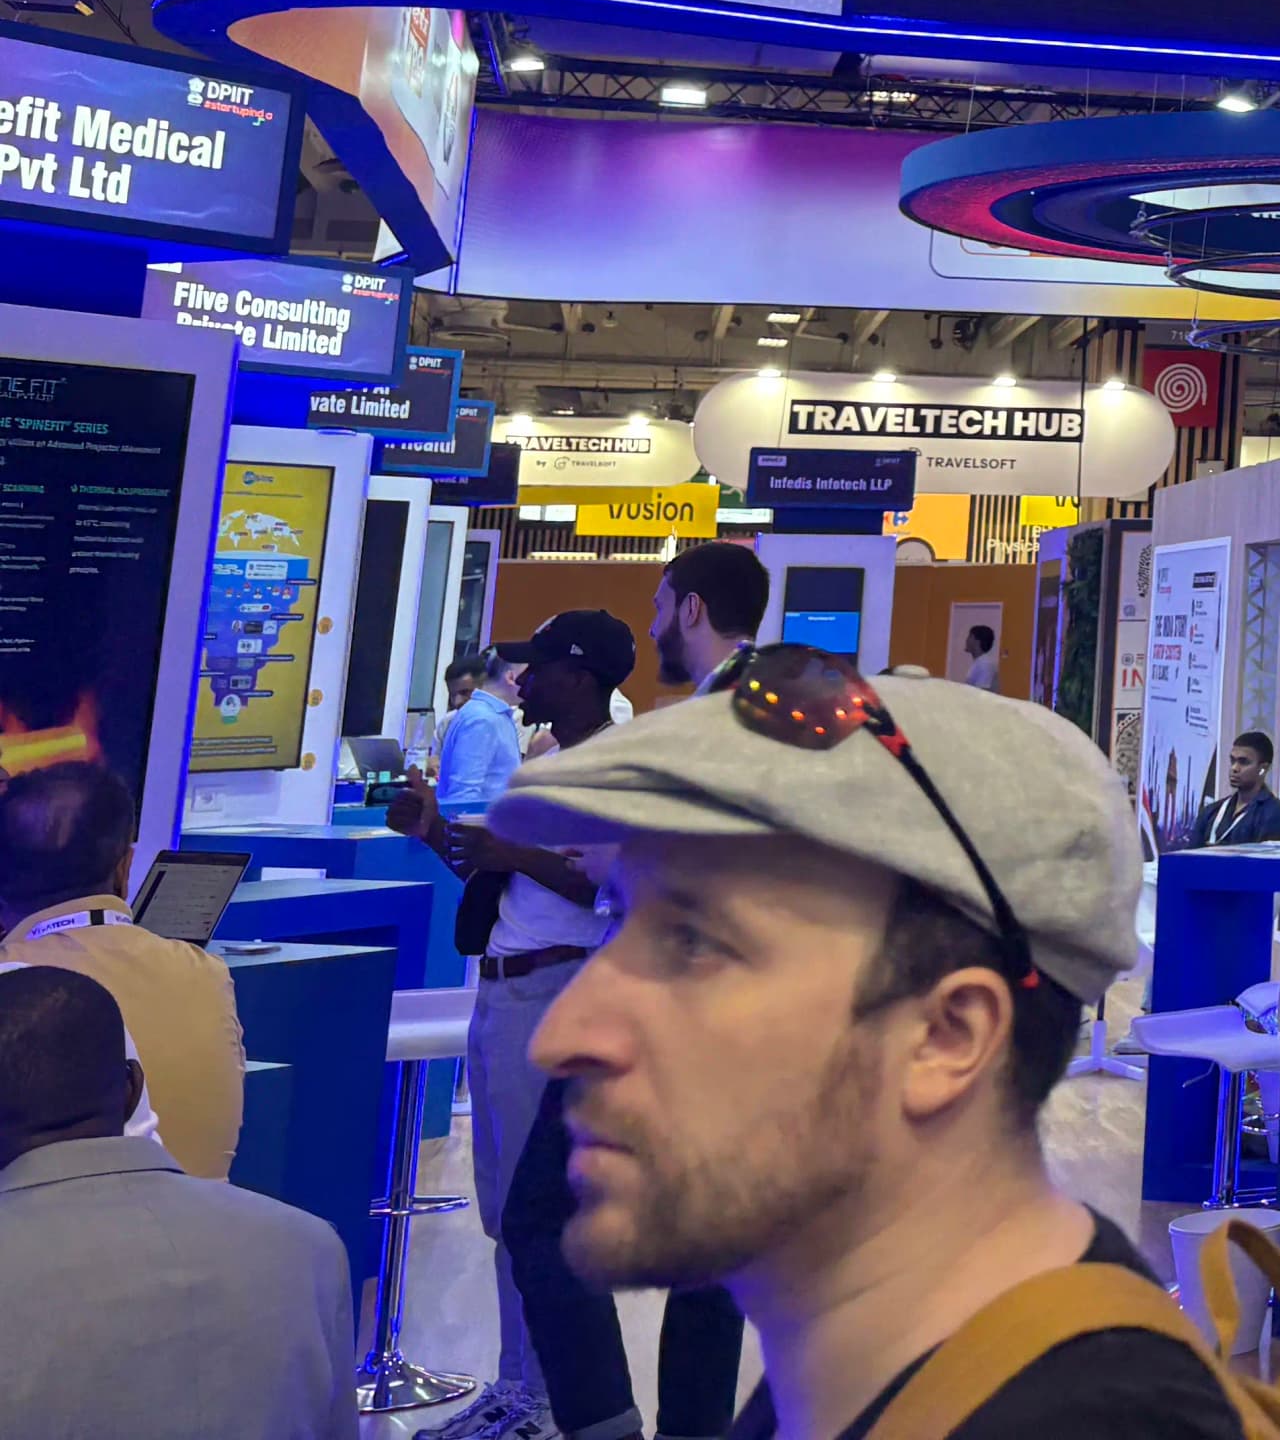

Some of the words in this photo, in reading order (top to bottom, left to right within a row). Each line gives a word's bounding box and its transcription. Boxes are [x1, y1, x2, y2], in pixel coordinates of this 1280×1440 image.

[207, 81, 254, 105] DPIIT
[72, 104, 226, 169] Medical
[0, 144, 58, 194] Pvt
[69, 156, 132, 204] Ltd
[354, 275, 386, 291] DPIIT
[174, 281, 229, 313] Flive
[235, 290, 351, 333] Consulting
[262, 323, 343, 356] Limited
[310, 395, 346, 415] vate
[351, 395, 409, 419] Limited
[72, 422, 109, 434] SERIES
[792, 404, 1013, 436] TRAVELTECH
[1014, 410, 1081, 438] HUB
[615, 438, 650, 453] HUB
[926, 457, 1016, 470] TRAVELSOFT
[816, 477, 866, 491] Infotech
[870, 478, 892, 491] LLP
